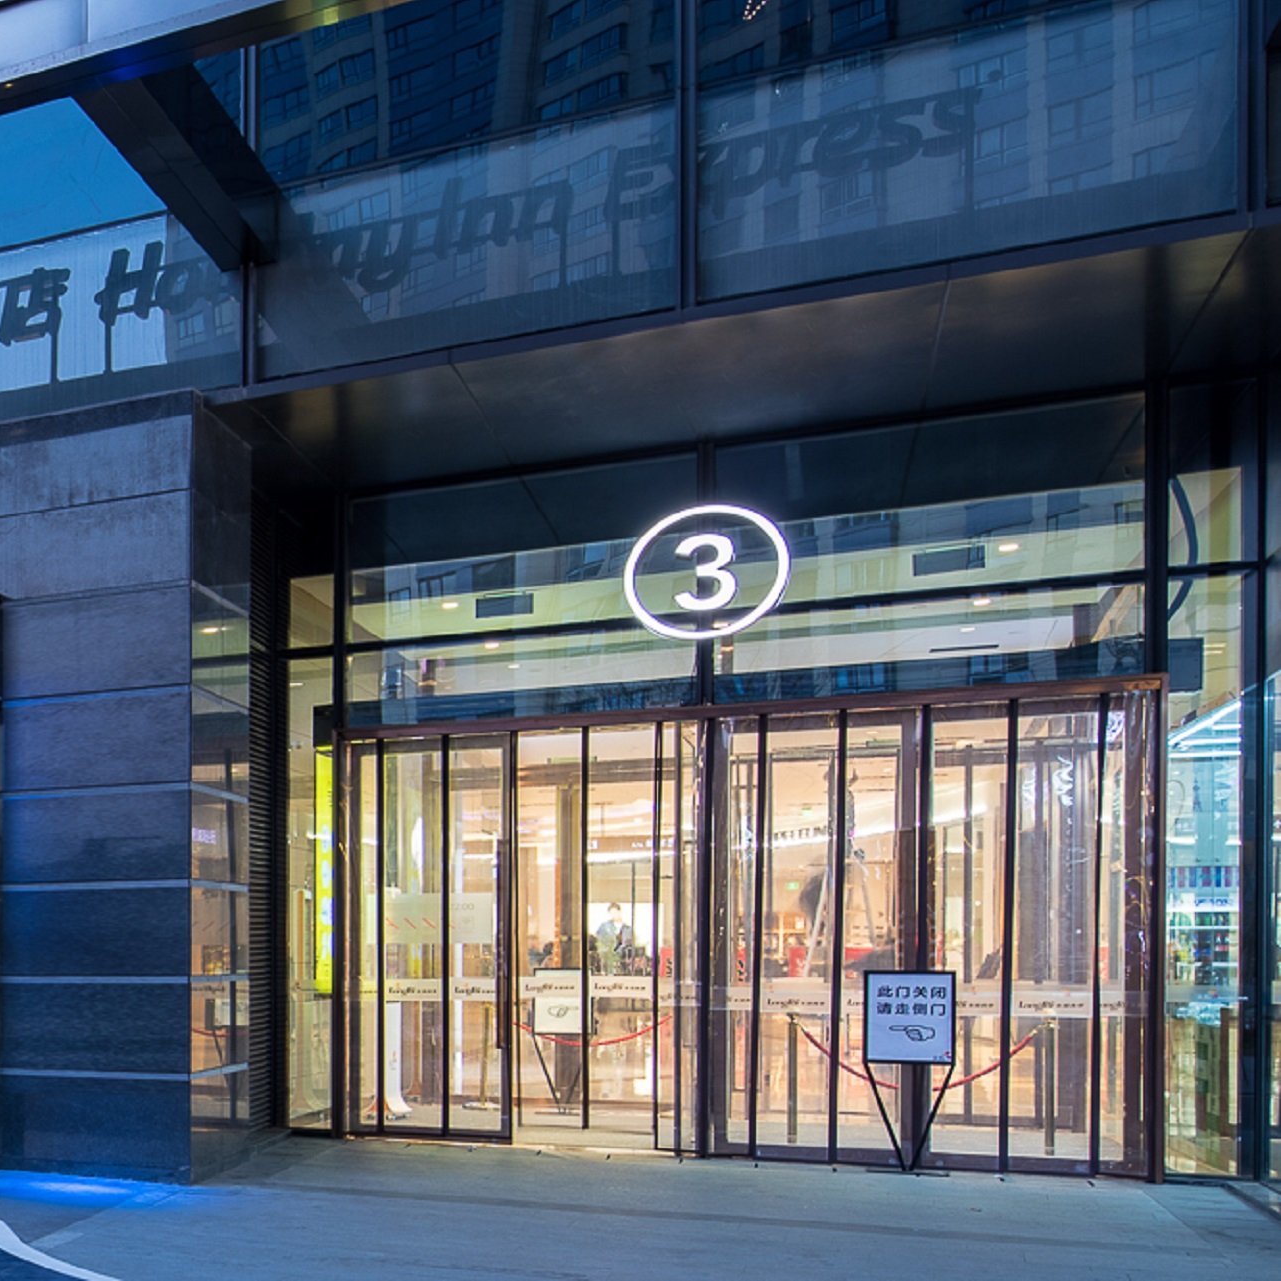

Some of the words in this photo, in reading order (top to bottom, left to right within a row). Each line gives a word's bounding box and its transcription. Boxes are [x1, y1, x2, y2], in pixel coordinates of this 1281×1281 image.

[674, 532, 739, 611] 3
[877, 985, 947, 1000] 此门关闭
[877, 1001, 947, 1017] 请走侧门
